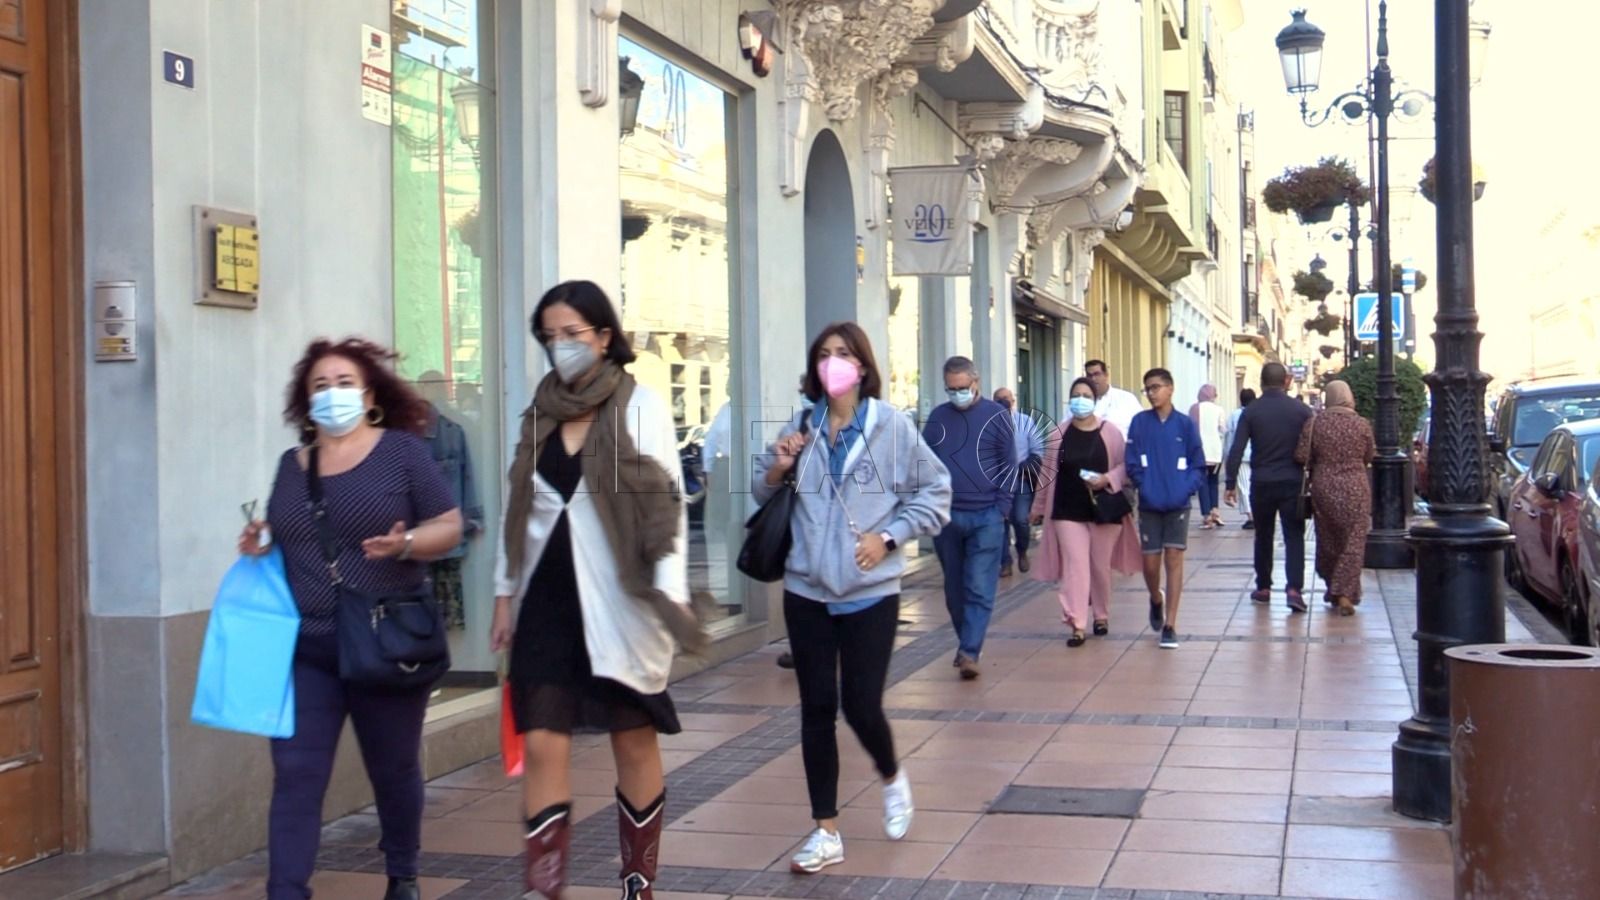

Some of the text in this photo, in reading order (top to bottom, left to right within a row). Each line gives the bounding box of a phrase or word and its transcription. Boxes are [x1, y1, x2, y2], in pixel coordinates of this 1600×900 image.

[175, 59, 185, 81] 9
[904, 218, 955, 231] VEINTE
[914, 203, 945, 238] 20
